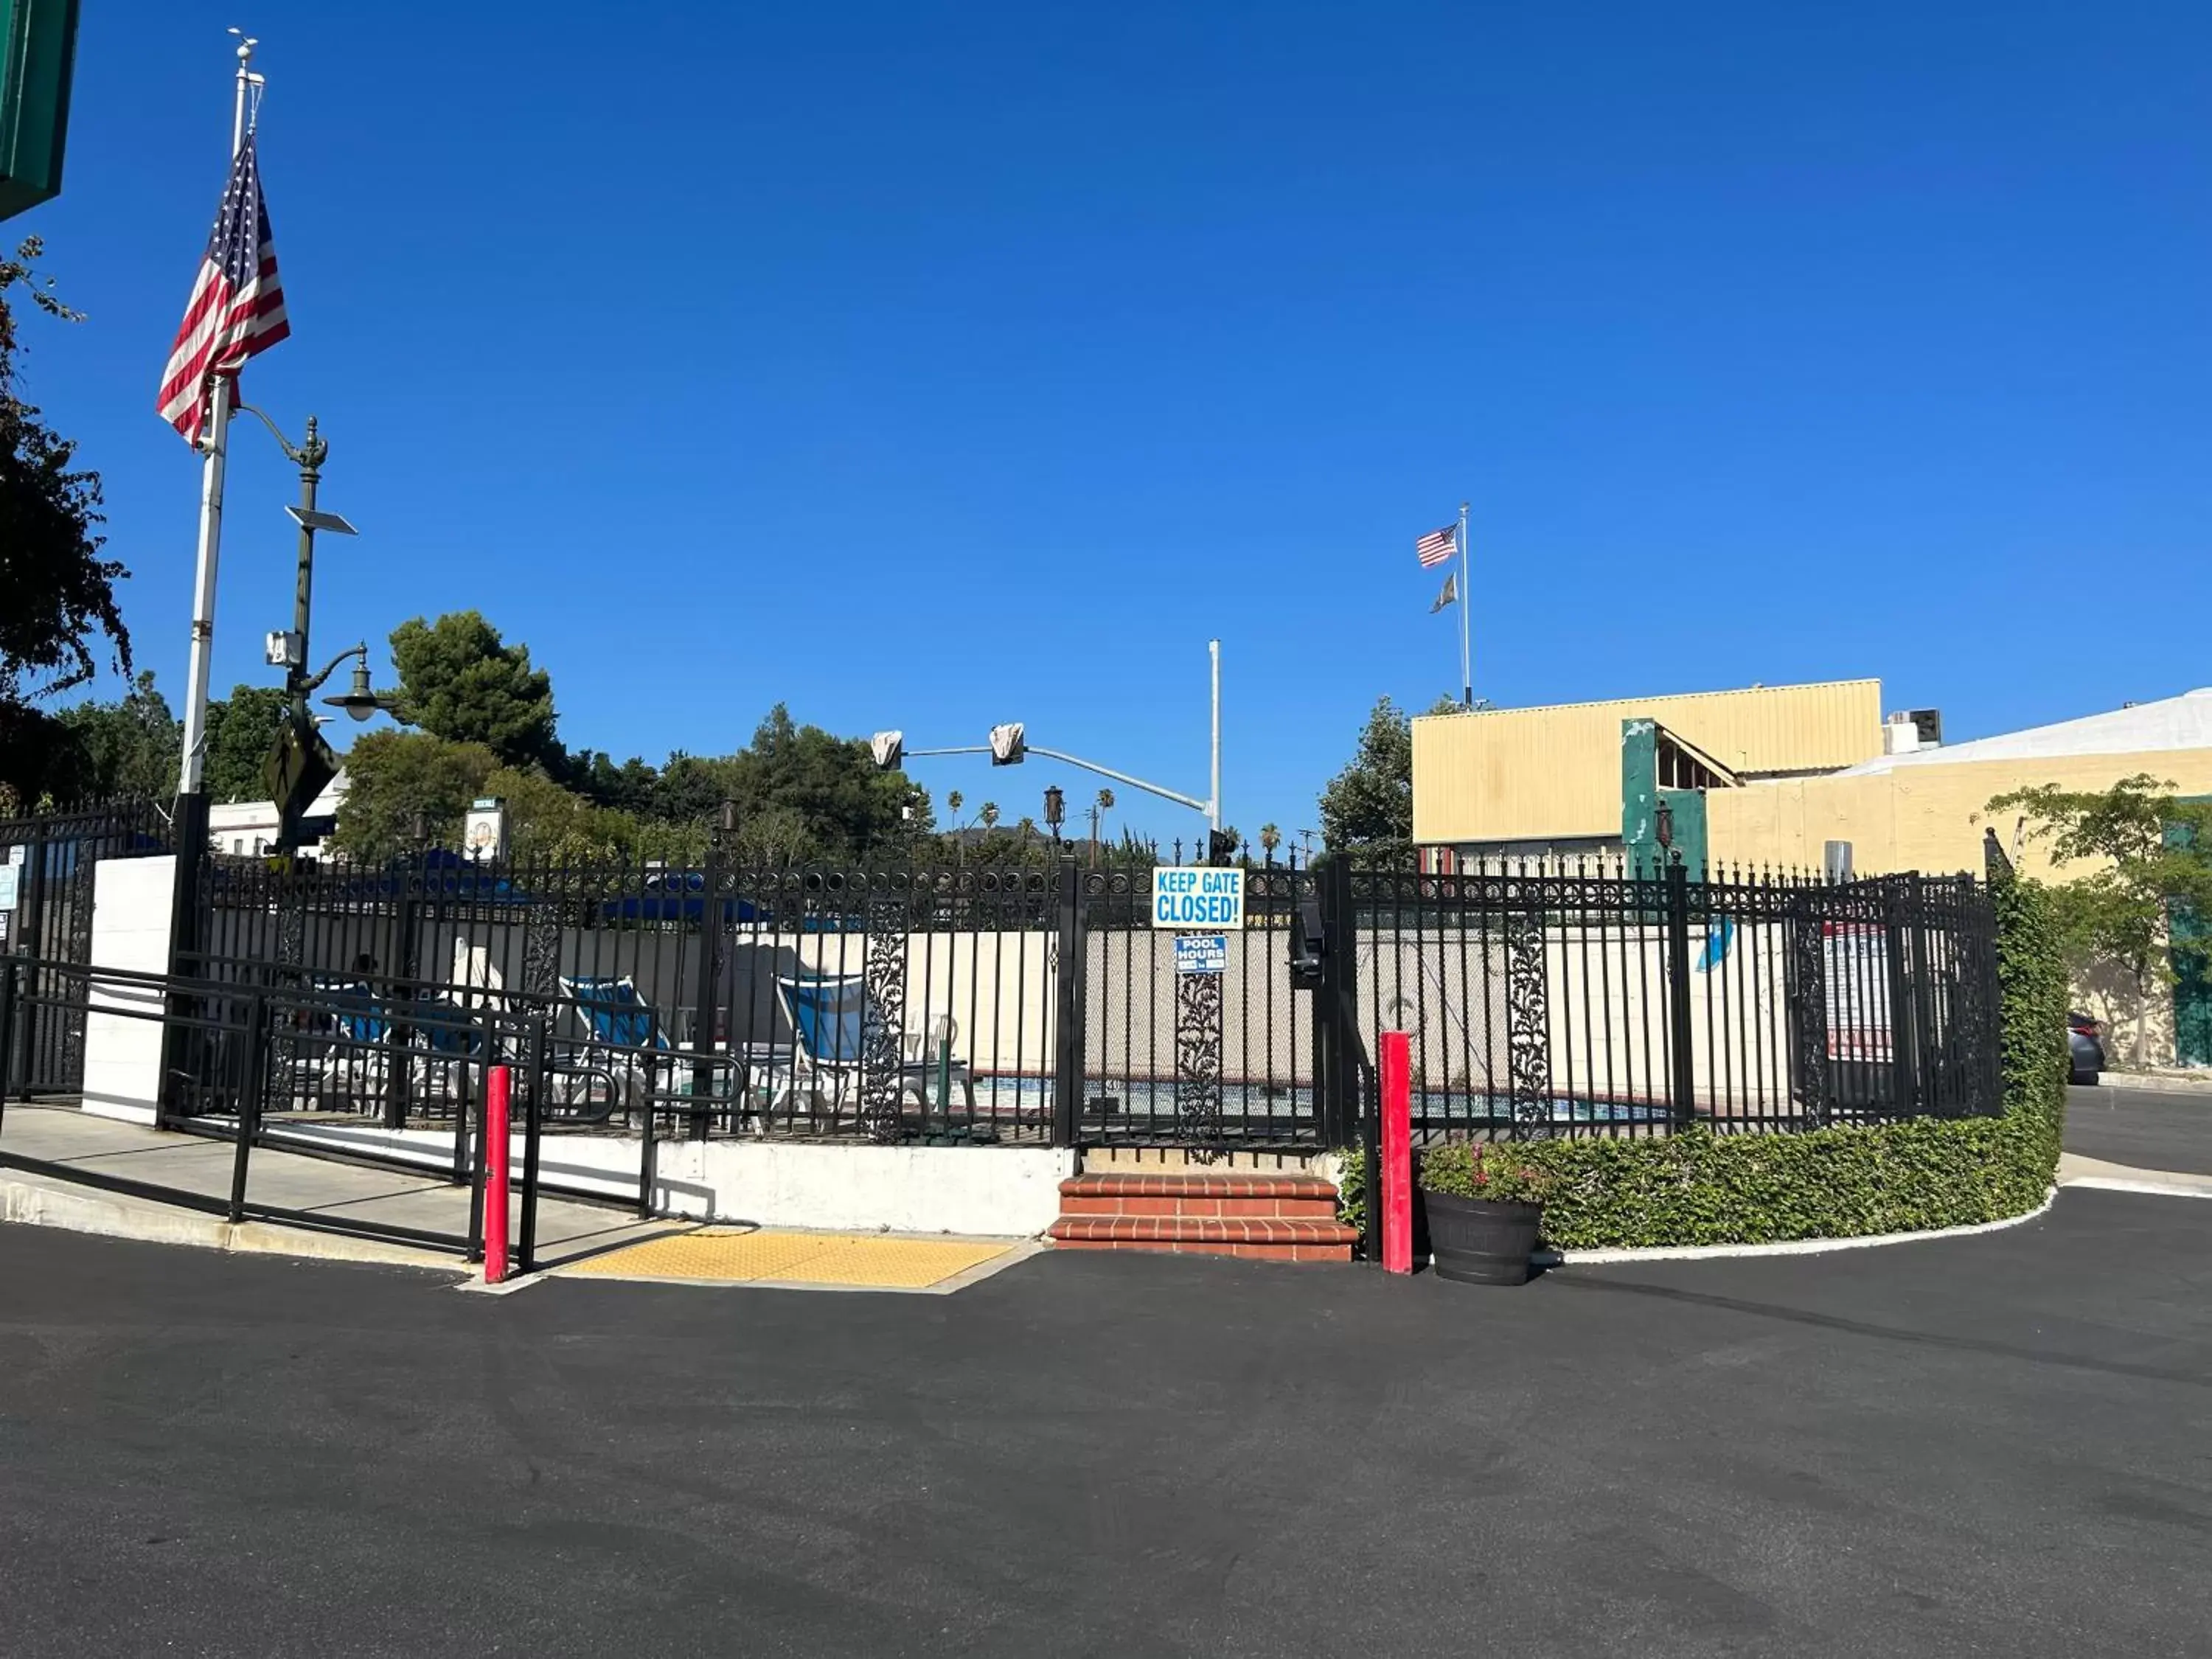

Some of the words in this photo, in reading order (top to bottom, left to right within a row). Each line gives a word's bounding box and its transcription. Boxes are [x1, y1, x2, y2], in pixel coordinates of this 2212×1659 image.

[1158, 872, 1197, 892] KEEP
[1203, 872, 1239, 894] GATE
[1158, 894, 1239, 924] CLOSED!
[1183, 939, 1219, 949] POOL
[1178, 948, 1224, 959] HOURS
